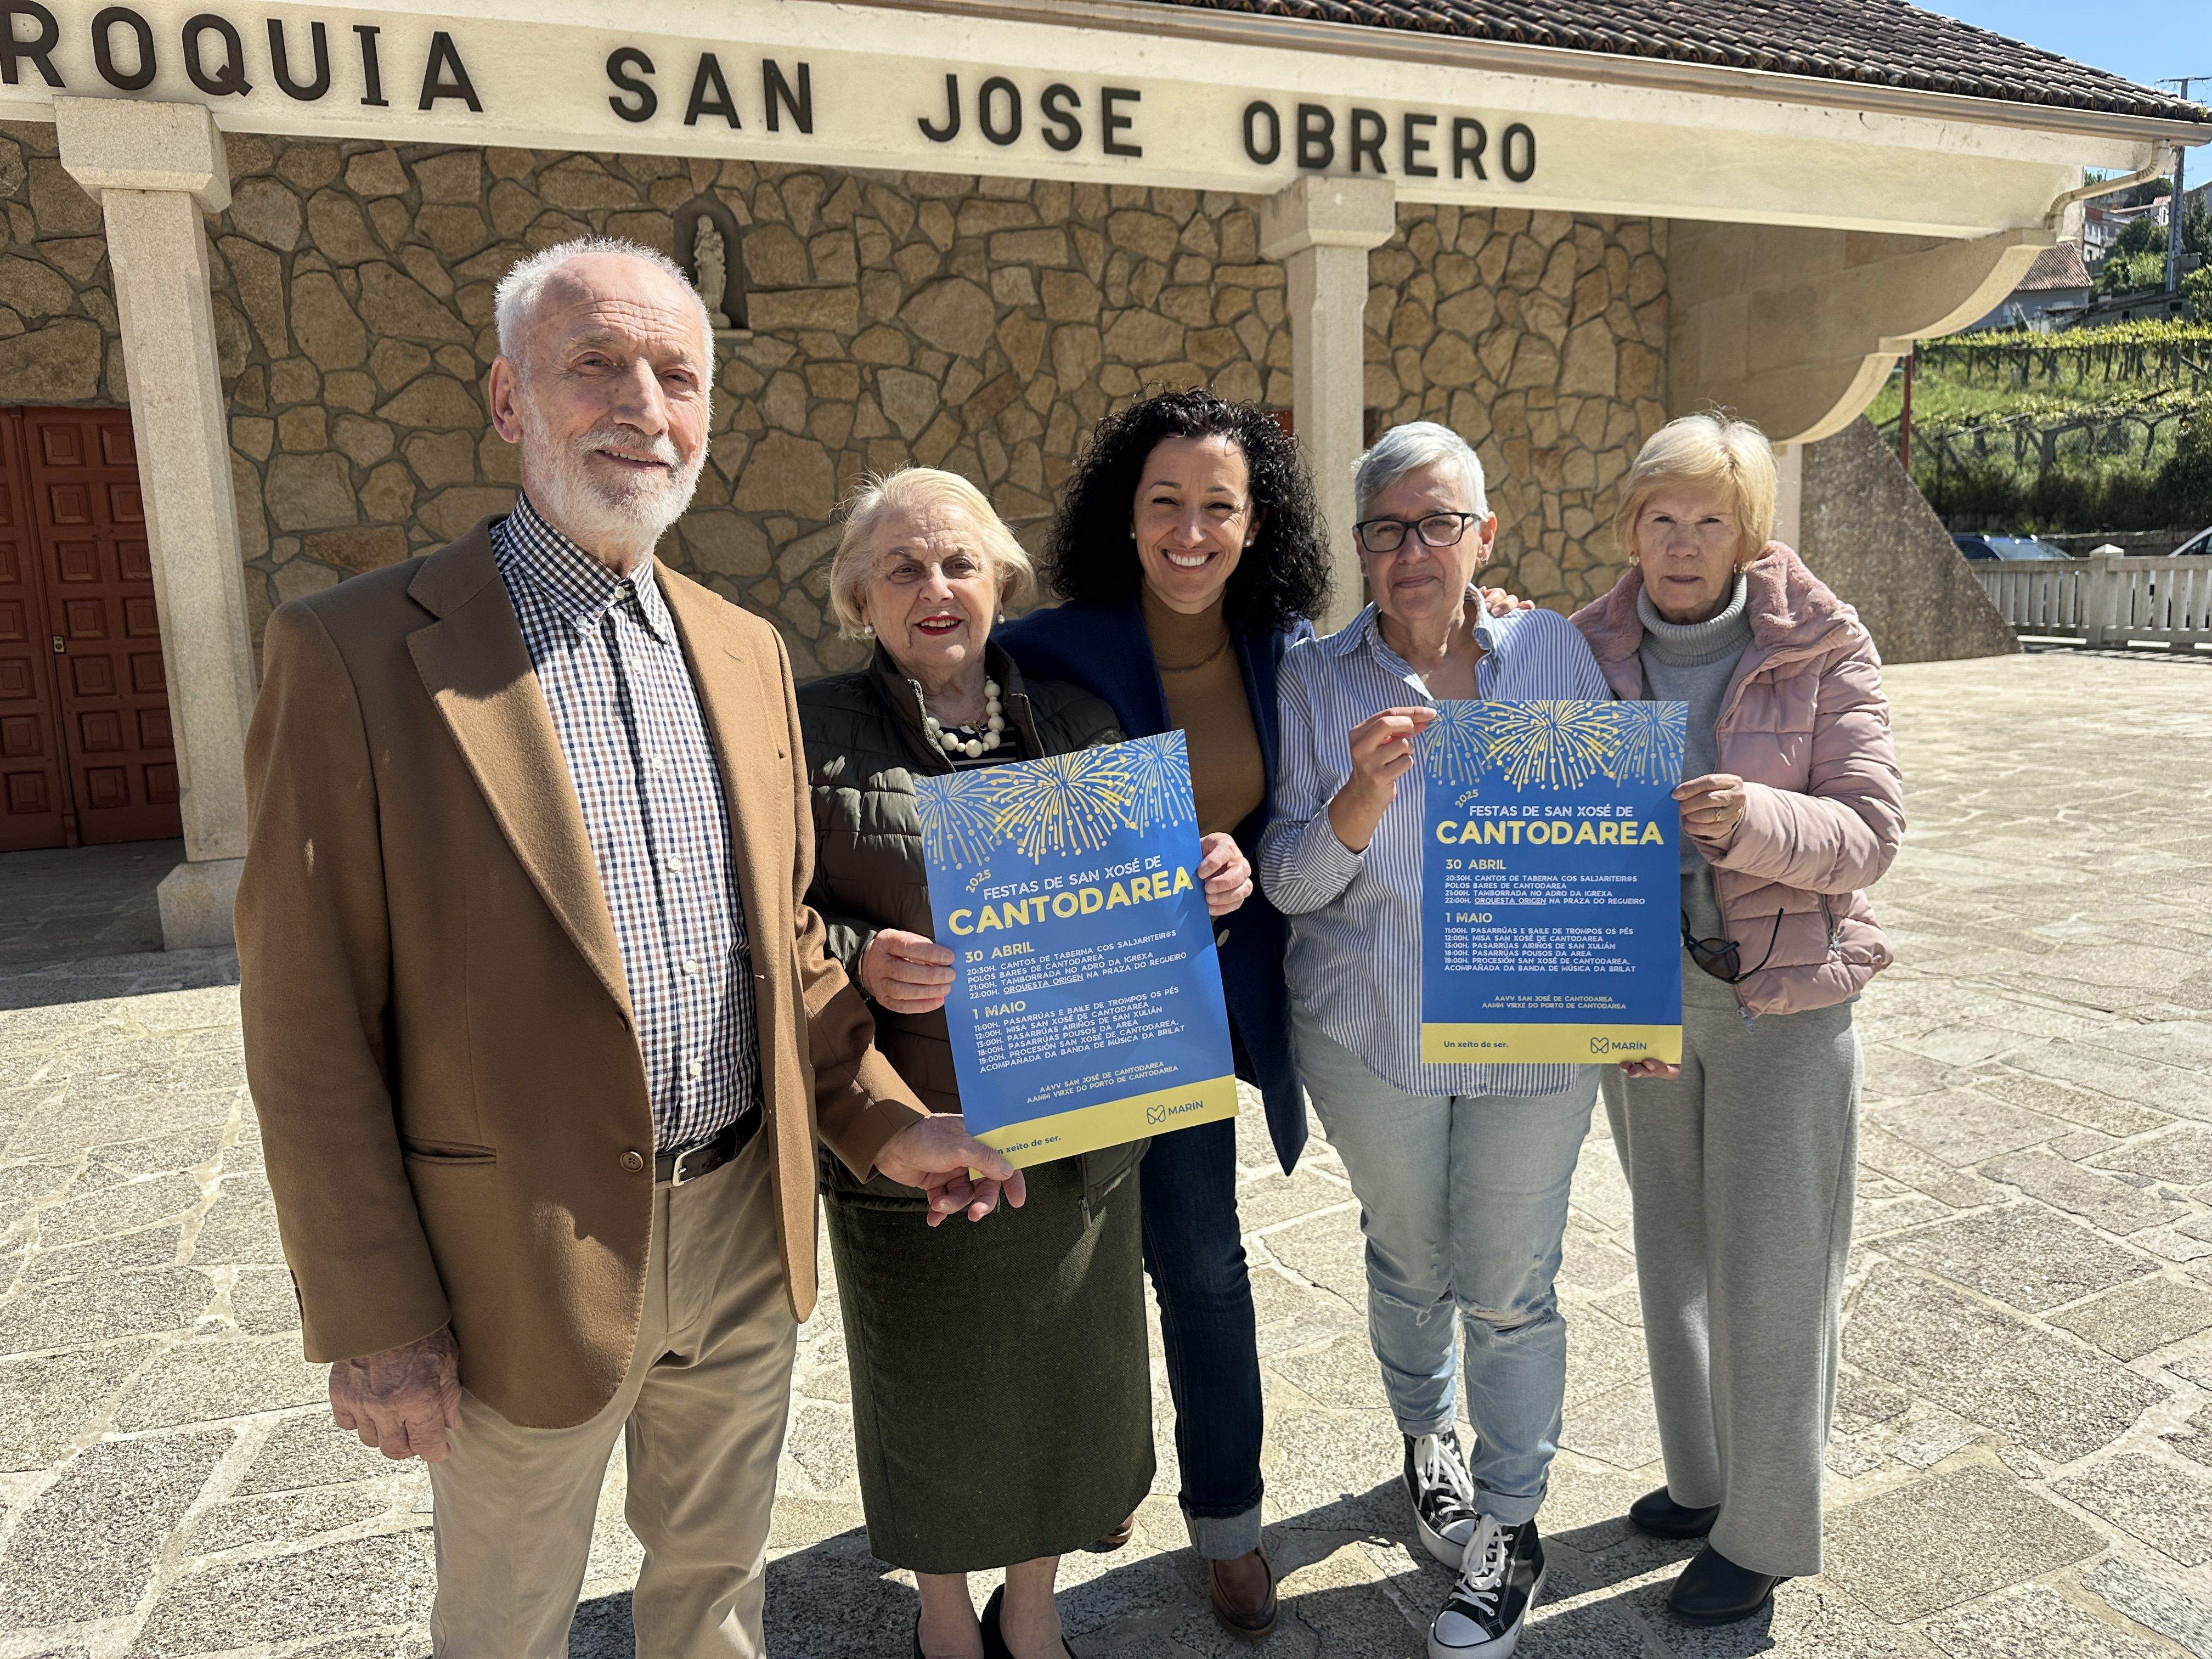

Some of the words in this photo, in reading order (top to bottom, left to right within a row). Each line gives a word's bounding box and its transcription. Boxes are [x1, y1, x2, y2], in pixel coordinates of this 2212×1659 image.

[606, 47, 813, 134] SAN
[918, 74, 1142, 157] JOSE
[1243, 100, 1536, 183] OBRERO
[1455, 789, 1479, 808] 2025
[1470, 805, 1517, 816] FESTAS
[1522, 806, 1539, 816] DE
[1544, 806, 1571, 816] SAN
[1577, 803, 1611, 816] XOSÉ
[1616, 806, 1633, 816] DE
[1436, 821, 1663, 845] CANTODAREA
[984, 881, 1038, 899] FESTAS
[1044, 876, 1063, 889] DE
[1069, 870, 1099, 884] SAN
[1104, 858, 1140, 878] XOSÉ
[1144, 855, 1161, 869] DE
[1446, 859, 1462, 869] 30
[1468, 859, 1505, 869] ABRIL
[966, 869, 991, 893] 2025
[949, 866, 1194, 935] CANTODAREA
[1445, 912, 1449, 922] 1
[1456, 912, 1492, 922] MAIO
[964, 950, 983, 962] 30
[991, 941, 1034, 958] ABRIL
[967, 965, 996, 975] 20:30H.
[1000, 958, 1035, 969] CANTOS
[1054, 947, 1093, 959] TABERNA
[1097, 943, 1114, 951] COS
[967, 973, 995, 983] POLOS
[999, 967, 1027, 978] BARES
[1045, 954, 1103, 969] CANTODAREA
[968, 981, 996, 991] 21:00H.
[1001, 970, 1060, 985] TAMBORRADA
[1081, 961, 1105, 971] ADRO
[1124, 952, 1153, 962] IGREXA
[969, 989, 999, 998] 22:00H.
[1003, 980, 1048, 994] ORQUESTA
[1052, 973, 1083, 985] ORIGEN
[1102, 964, 1131, 975] PRAZA
[1149, 952, 1186, 966] REGUEIRO
[972, 1008, 978, 1019] 1
[985, 1001, 1025, 1017] MAIO
[974, 1021, 1000, 1031] 11:00H.
[1003, 1011, 1054, 1025] PASARRÚAS
[1067, 1004, 1090, 1014] BAILE
[1108, 994, 1147, 1006] TROMPOS
[1164, 986, 1178, 995] PÉS
[975, 1029, 1002, 1039] 12:00H.
[1006, 1024, 1026, 1033] MISA
[1030, 1020, 1048, 1028] SAN
[1052, 1014, 1073, 1024] XOSÉ
[1077, 1013, 1088, 1021] DE
[1091, 1002, 1148, 1017] CANTODAREA
[976, 1037, 1003, 1048] 13:00H.
[1007, 1026, 1058, 1041] PASARRÚAS
[1062, 1019, 1094, 1030] AIRIÑOS
[1113, 1013, 1130, 1021] SAN
[1133, 1006, 1162, 1017] XULIÁN
[977, 1045, 1005, 1056] 18:00H.
[1008, 1034, 1059, 1049] PASARRÚAS
[1063, 1027, 1096, 1038] POUSOS
[1116, 1019, 1138, 1029] AREA
[978, 1053, 1006, 1064] 19:00H.
[1009, 1043, 1056, 1057] PROCESIÓN
[1059, 1039, 1076, 1047] SAN
[1080, 1034, 1102, 1043] XOSÉ
[980, 1054, 1041, 1073] ACOMPAÑADA
[1060, 1045, 1090, 1055] BANDA
[1108, 1035, 1138, 1046] MÚSICA
[1157, 1025, 1184, 1036] BRILAT
[1612, 1041, 1646, 1049] MARÍN
[1053, 1087, 1073, 1096] VIRXE
[1090, 1079, 1114, 1088] PORTO
[1129, 1065, 1178, 1080] CANTODAREA
[1064, 1079, 1079, 1087] SAN
[1082, 1074, 1099, 1082] JOSÉ
[1114, 1062, 1164, 1075] CANTODAREA
[1168, 1100, 1203, 1115] MARÍN
[1006, 1143, 1028, 1152] xeito
